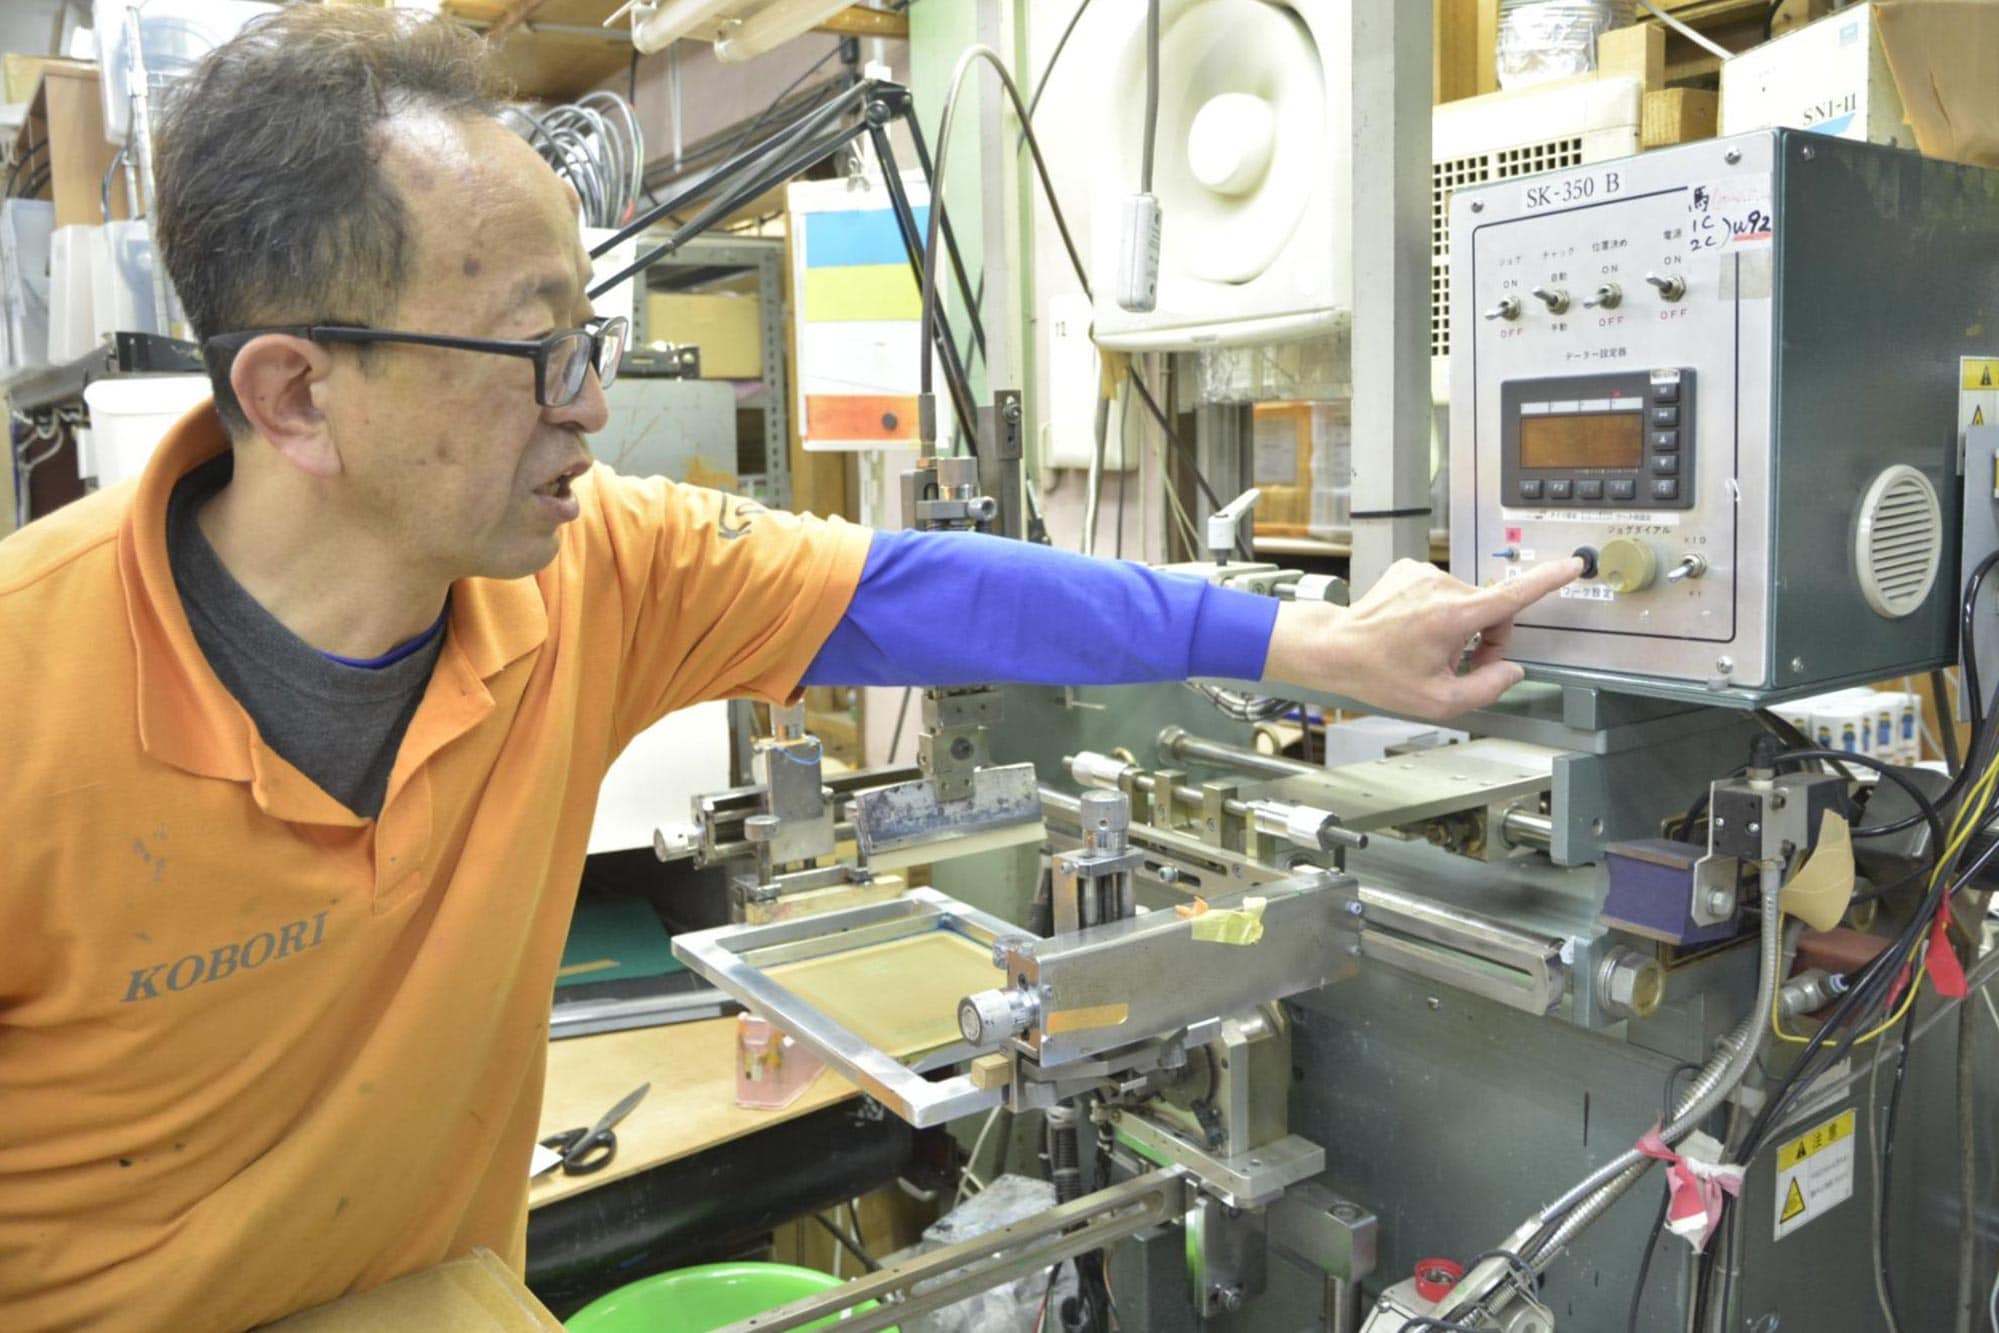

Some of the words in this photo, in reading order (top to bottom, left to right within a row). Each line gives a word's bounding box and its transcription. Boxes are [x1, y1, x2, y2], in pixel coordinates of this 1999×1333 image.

[1526, 177, 1595, 209] SK-350
[1606, 172, 1621, 194] B
[1591, 238, 1629, 253] 位置決め
[1663, 255, 1682, 265] ON
[1601, 265, 1619, 274] ON
[1503, 279, 1519, 289] ON
[1660, 308, 1688, 320] OFF
[1598, 316, 1625, 327] OFF
[1500, 328, 1524, 338] OFF
[120, 910, 329, 1003] KOBORI
